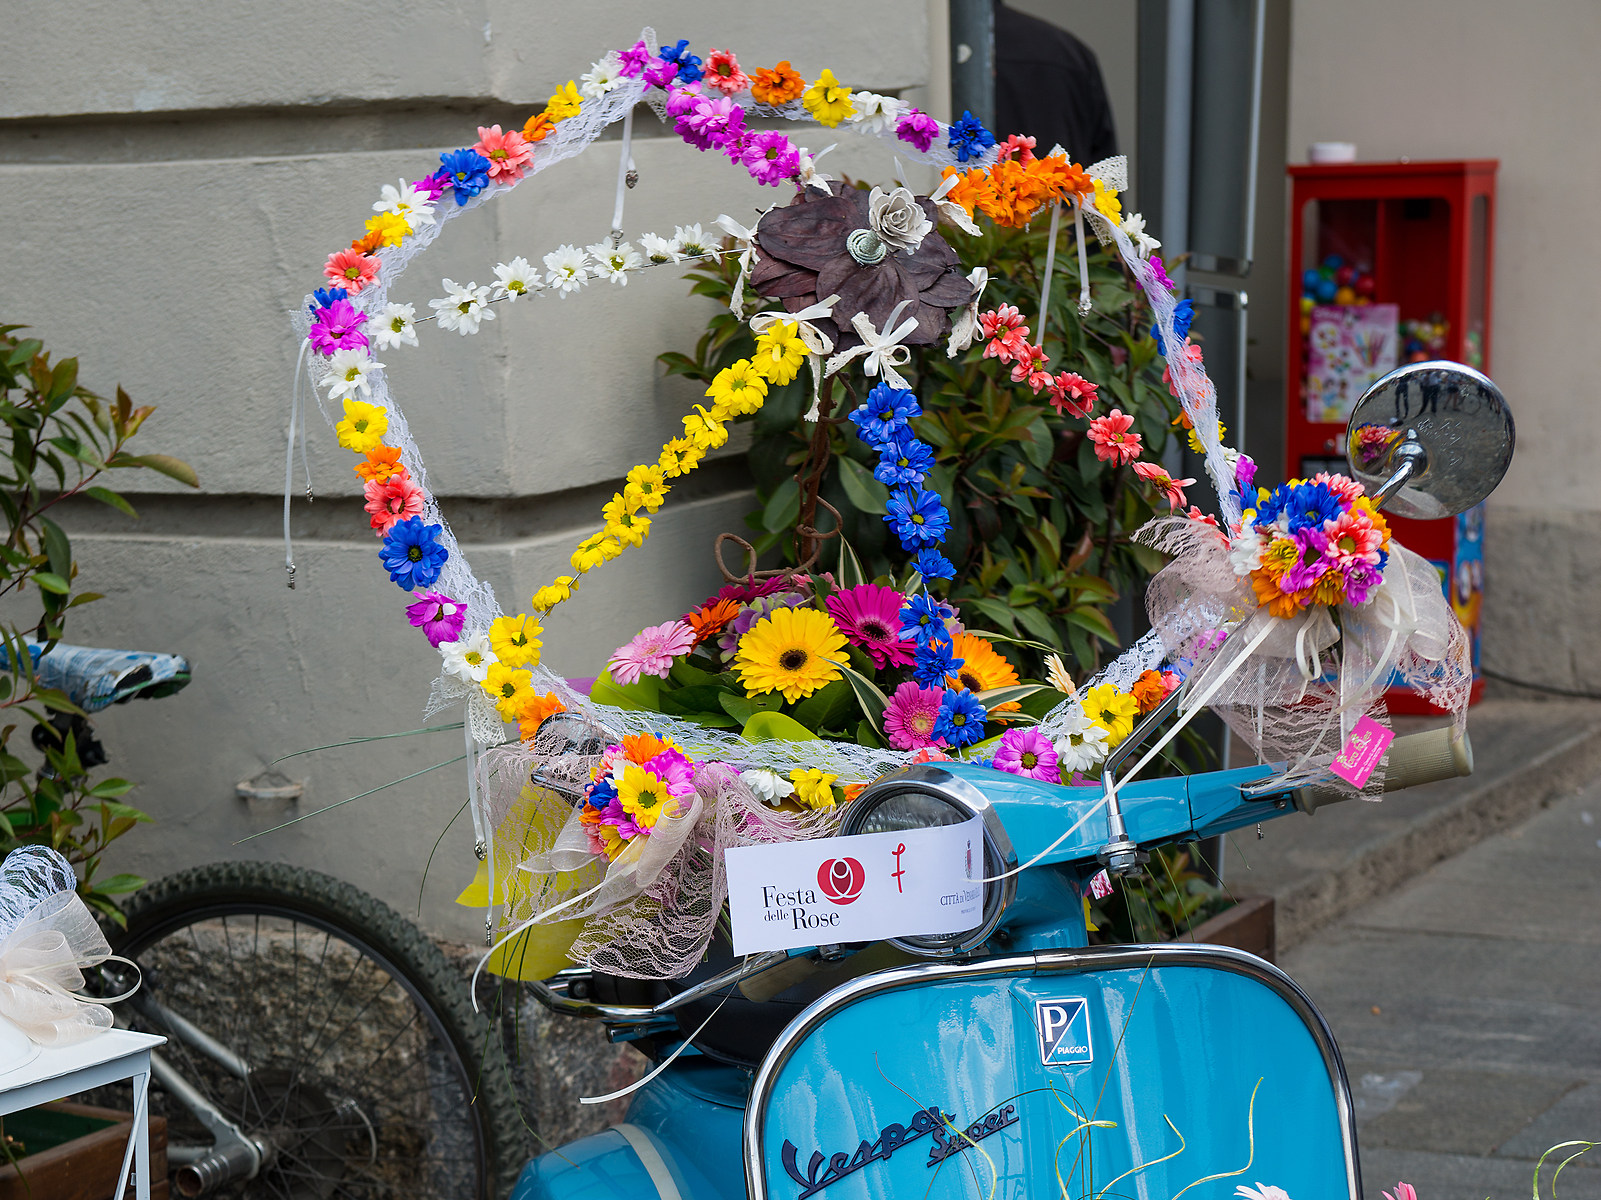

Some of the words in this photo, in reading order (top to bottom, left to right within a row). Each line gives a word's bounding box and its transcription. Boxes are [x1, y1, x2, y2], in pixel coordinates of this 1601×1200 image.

[761, 885, 817, 908] Festa
[763, 909, 789, 922] delle
[791, 907, 840, 930] Rose
[1042, 1006, 1067, 1042] P
[1057, 1045, 1089, 1055] PIAGGIO
[926, 1104, 1020, 1168] Super
